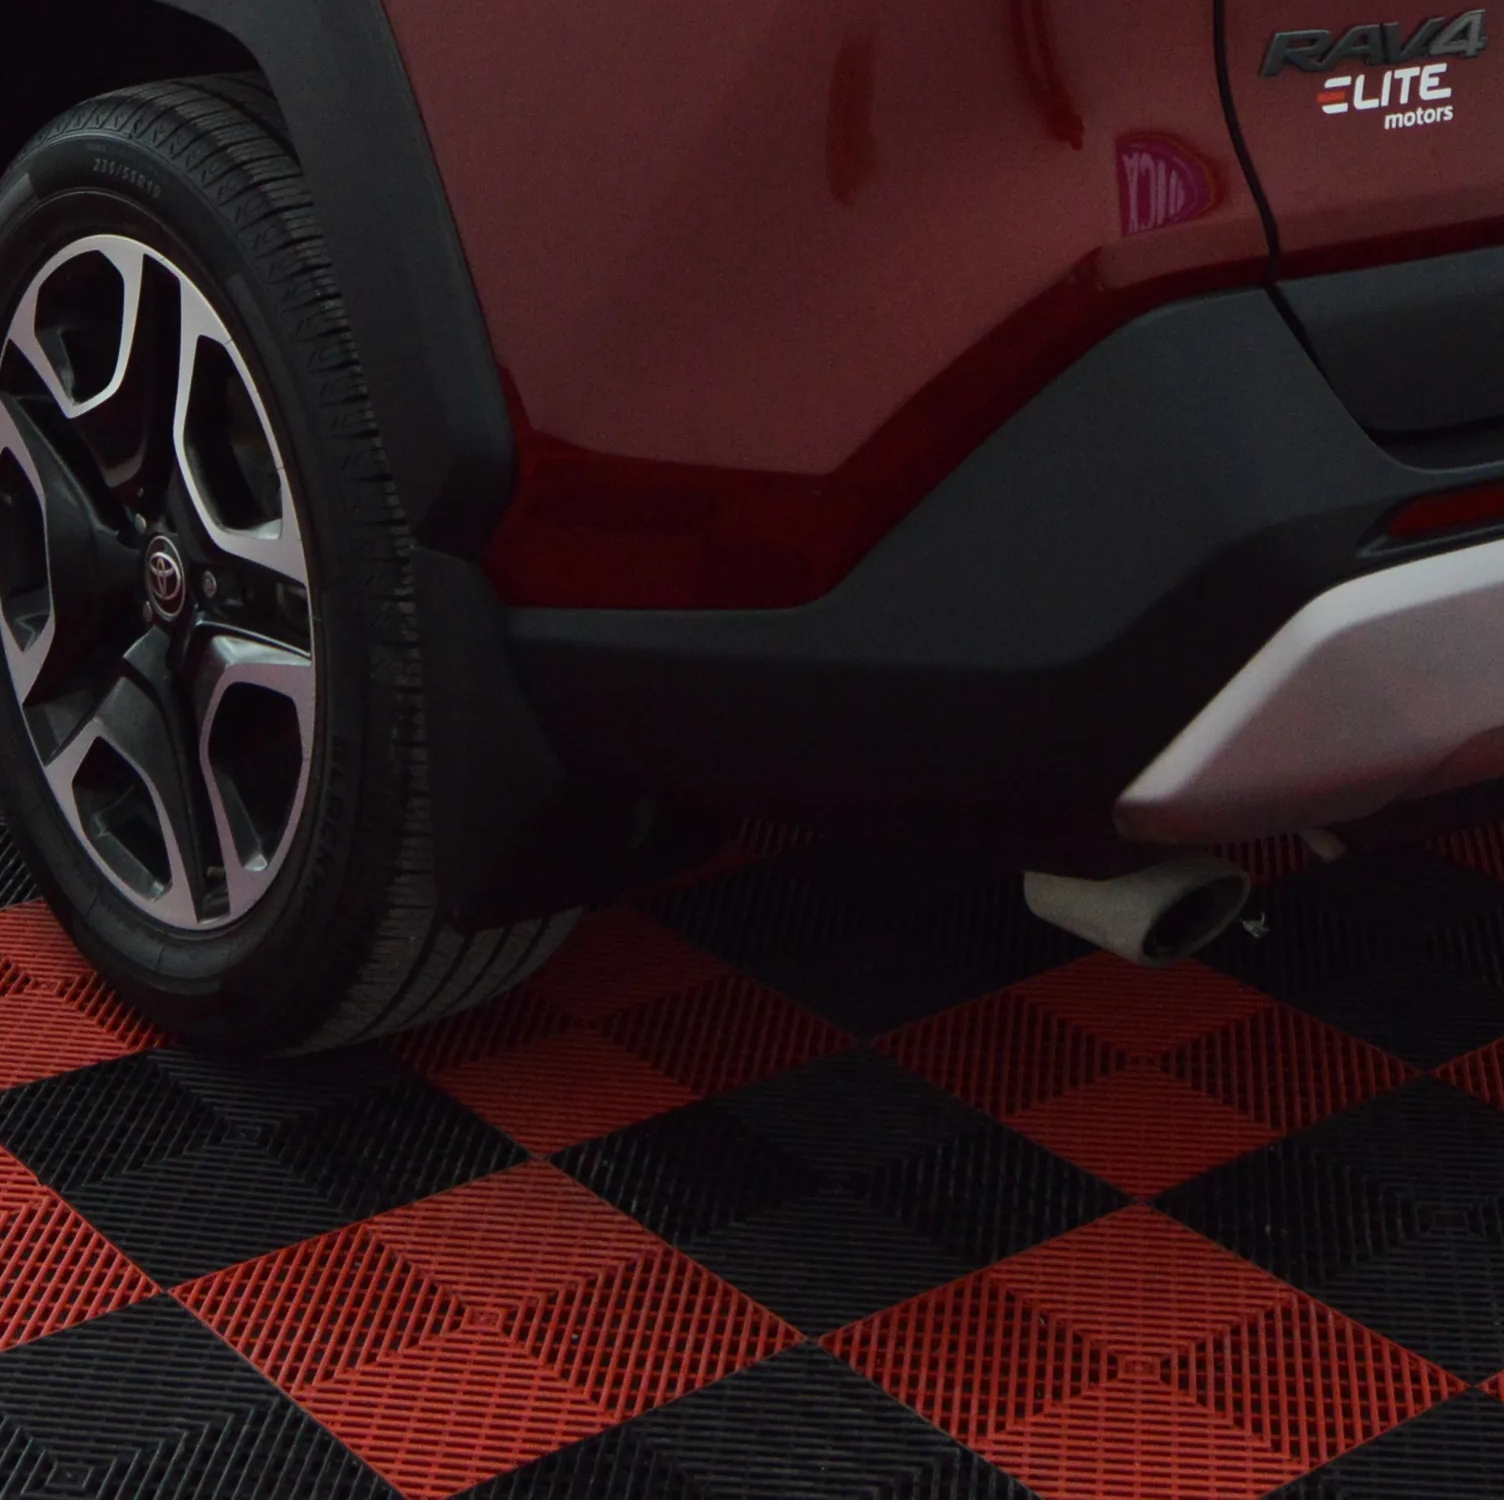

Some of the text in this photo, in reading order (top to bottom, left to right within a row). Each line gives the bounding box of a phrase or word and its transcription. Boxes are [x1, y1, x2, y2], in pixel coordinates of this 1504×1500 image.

[1261, 8, 1487, 77] RAV4
[1317, 62, 1452, 115] ELITE
[1384, 104, 1454, 130] motors
